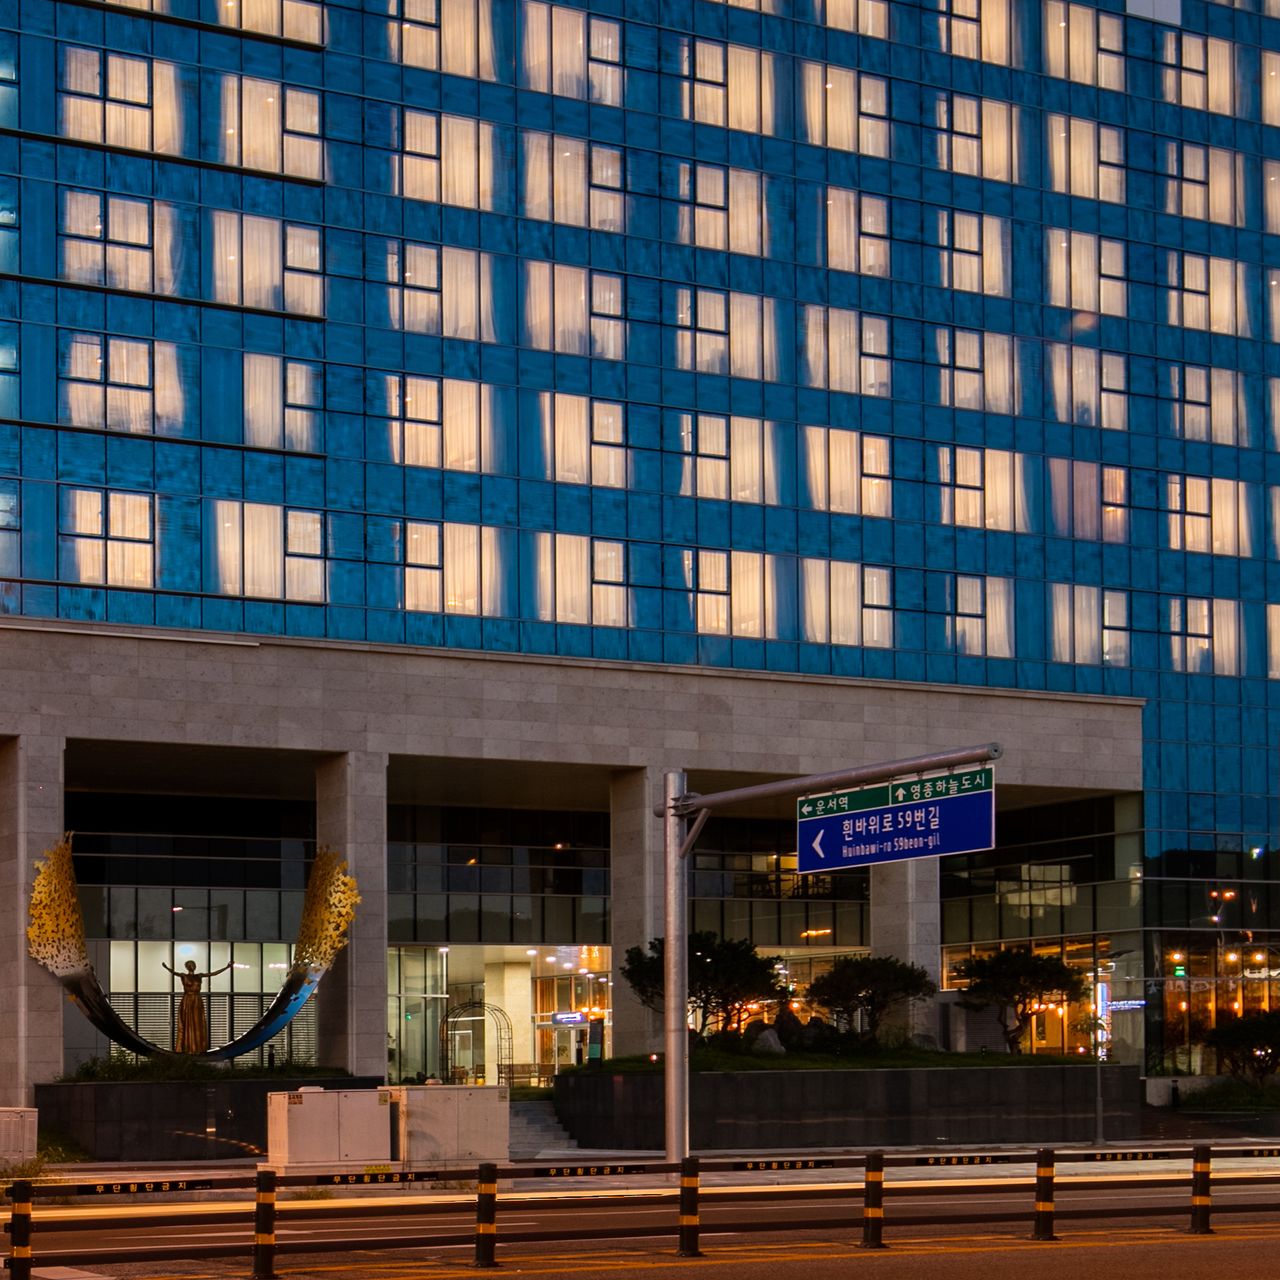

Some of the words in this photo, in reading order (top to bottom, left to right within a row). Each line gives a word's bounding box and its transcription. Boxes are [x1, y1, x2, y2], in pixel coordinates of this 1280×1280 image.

[815, 796, 849, 815] 운서역
[842, 840, 892, 858] Huinbawi-ro
[894, 832, 940, 852] 59beon-gil
[96, 1182, 186, 1193] 무단횡단금지
